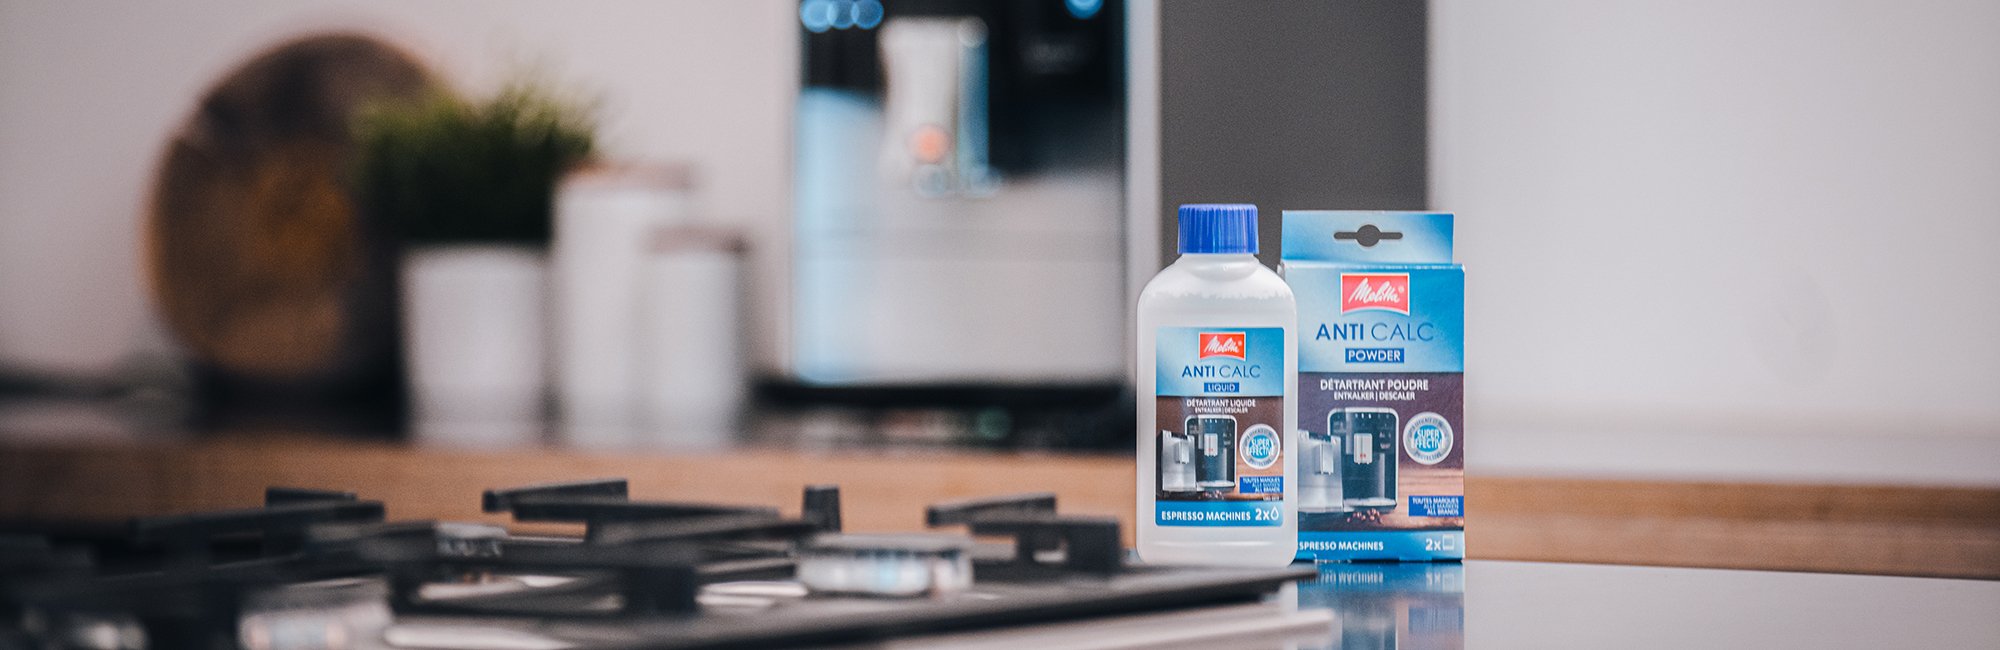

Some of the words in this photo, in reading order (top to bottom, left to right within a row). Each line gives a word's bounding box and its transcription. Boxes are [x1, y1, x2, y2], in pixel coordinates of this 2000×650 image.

[1315, 323, 1364, 341] ANTI
[1370, 322, 1435, 341] CALC
[1348, 350, 1401, 362] POWDER
[1181, 365, 1216, 378] ANTI
[1218, 364, 1261, 379] CALC
[1207, 383, 1236, 393] LIQUID
[1320, 378, 1386, 391] DÉTARTRANT
[1387, 379, 1429, 391] POUDRE
[1333, 391, 1375, 401] ENTKALKER
[1379, 391, 1416, 401] DESCALER
[1230, 399, 1256, 408] LIQUIDE
[1417, 428, 1440, 440] SUPER
[1161, 511, 1204, 521] ESPRESSO
[1205, 511, 1251, 521] MACHINES
[1254, 508, 1271, 521] 2x
[1298, 541, 1337, 551] SPRESSO
[1338, 541, 1384, 551] MACHINES
[1425, 538, 1442, 551] 2x
